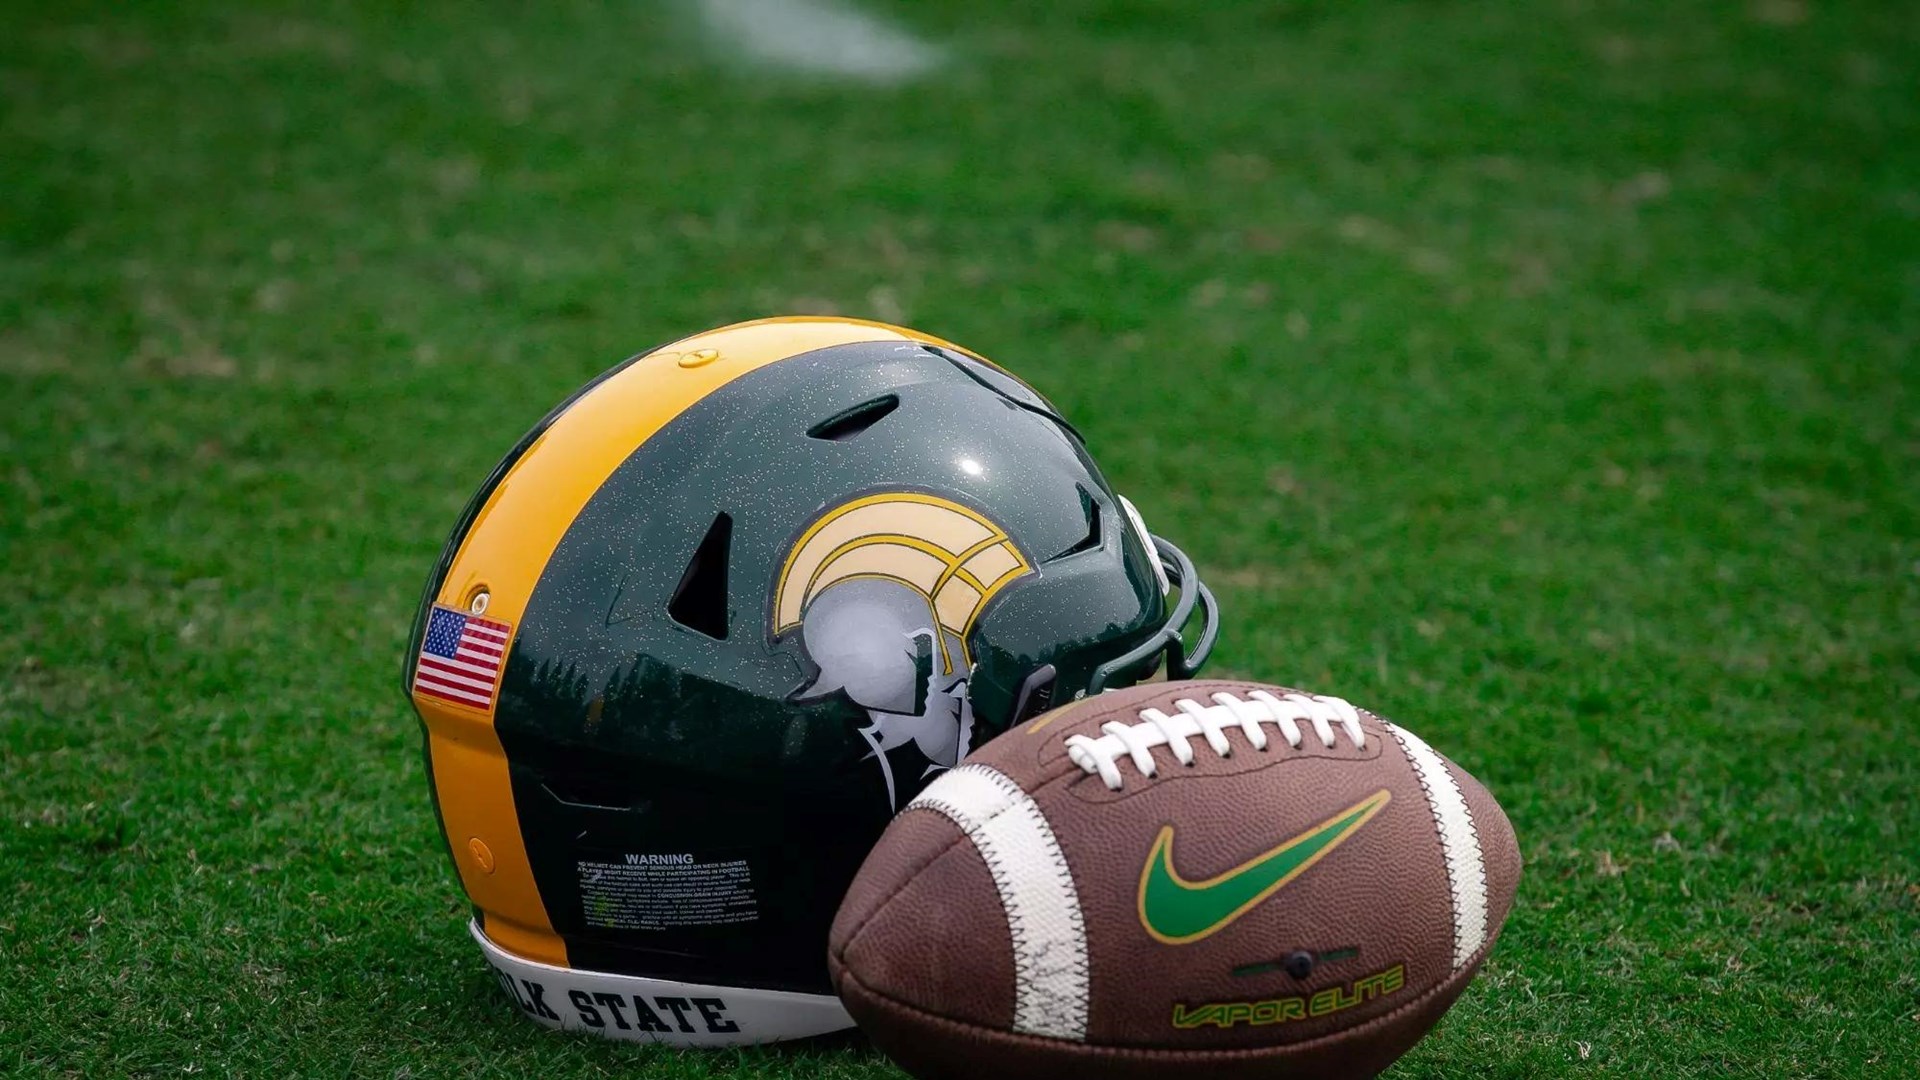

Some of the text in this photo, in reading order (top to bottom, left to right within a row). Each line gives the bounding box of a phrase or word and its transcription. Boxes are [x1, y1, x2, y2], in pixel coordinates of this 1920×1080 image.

[625, 853, 694, 865] WARNING
[719, 866, 750, 874] FOOTBALL
[1172, 964, 1405, 1029] VAPOR ELITE
[568, 989, 741, 1034] STATE
